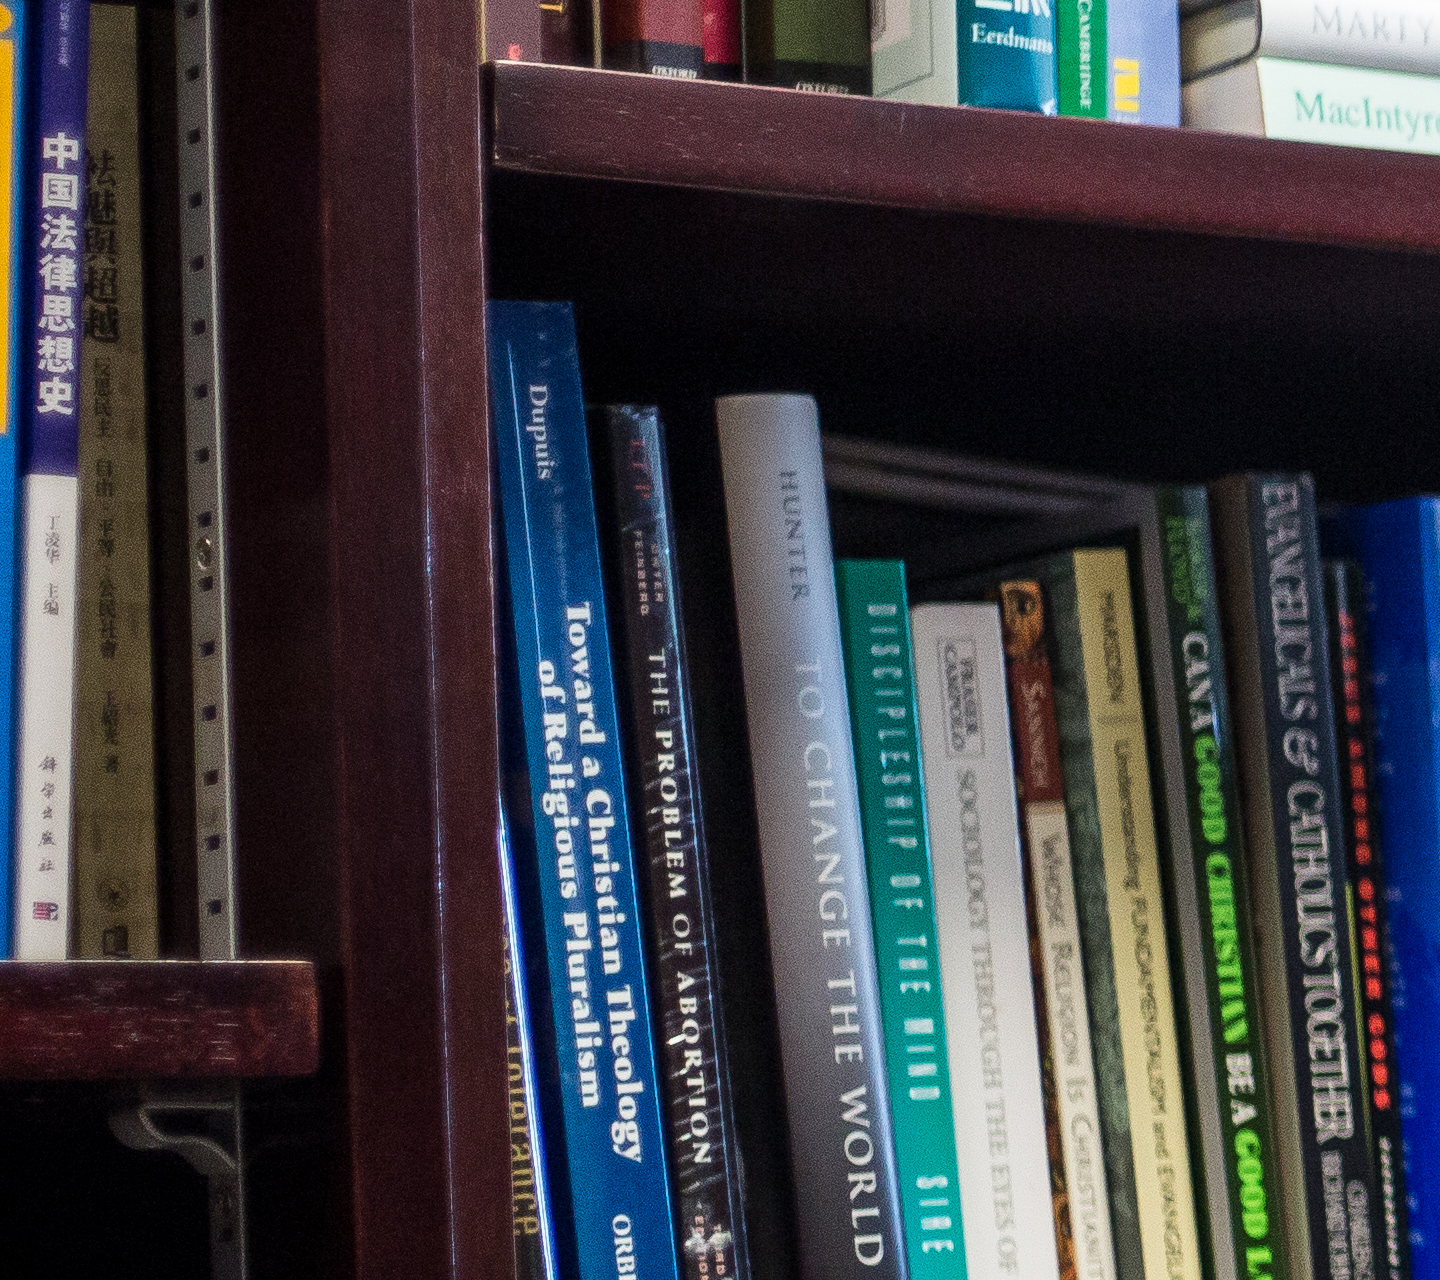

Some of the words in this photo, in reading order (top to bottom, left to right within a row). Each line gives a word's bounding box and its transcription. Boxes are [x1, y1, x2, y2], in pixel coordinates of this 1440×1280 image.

[38, 131, 81, 414] 中国法律思想史
[523, 383, 555, 481] Dupuis
[779, 470, 811, 602] HUNTER
[1261, 481, 1319, 720] EVANGELICALS
[537, 660, 567, 702] of
[564, 602, 606, 745] Toward
[648, 648, 670, 715] THE
[796, 661, 825, 719] TO
[867, 604, 918, 849] DISCIPLESHIP
[1181, 630, 1212, 703] CAN
[541, 711, 580, 899] Religious
[581, 756, 604, 778] a
[654, 728, 687, 899] PROBLEM
[1193, 734, 1227, 844] GOOD
[1284, 728, 1320, 776] &
[585, 788, 629, 975] Christian
[803, 741, 851, 948] CHANGE
[890, 874, 923, 909] OF
[1286, 781, 1339, 969] CATHOLICS
[673, 913, 693, 956] OF
[895, 935, 932, 995] THE
[1204, 851, 1249, 1044] CHRISTIAN
[563, 913, 603, 1108] Pluralism
[605, 985, 646, 1163] Theology
[675, 972, 712, 1164] ABORTION
[825, 975, 864, 1065] THE
[968, 943, 997, 1090] THROUGH
[1225, 1052, 1255, 1096] BE
[1302, 969, 1355, 1145] TOGETHER
[839, 1086, 885, 1267] WORLD
[1230, 1099, 1258, 1128] A
[1234, 1130, 1271, 1241] GOOD
